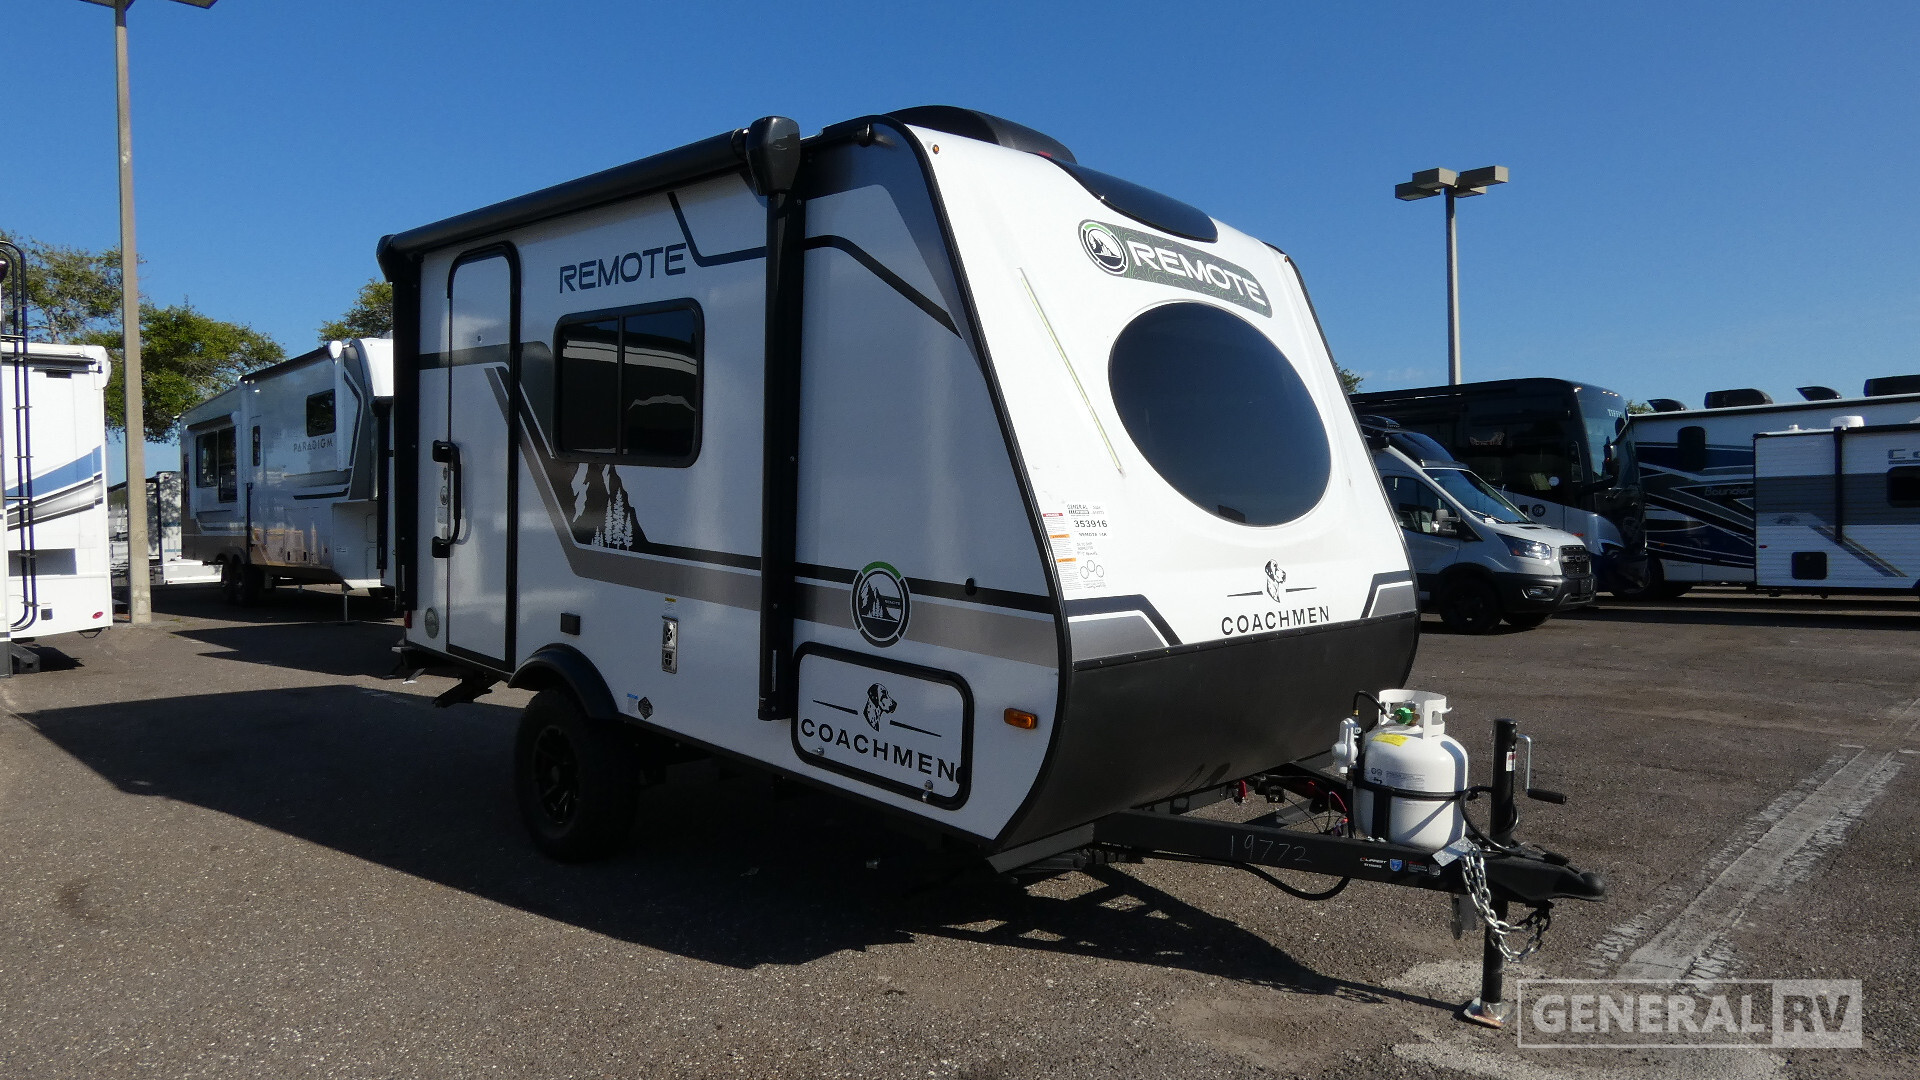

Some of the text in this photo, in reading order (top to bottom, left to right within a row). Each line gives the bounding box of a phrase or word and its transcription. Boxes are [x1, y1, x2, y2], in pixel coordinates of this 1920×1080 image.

[559, 243, 687, 294] REMOTE
[1126, 240, 1267, 306] REMOTE
[293, 438, 334, 452] PARADIGM
[1073, 519, 1108, 528] 353916
[1221, 605, 1330, 635] COACHMEN
[801, 718, 956, 782] COACHMEN
[1230, 835, 1312, 863] 19772
